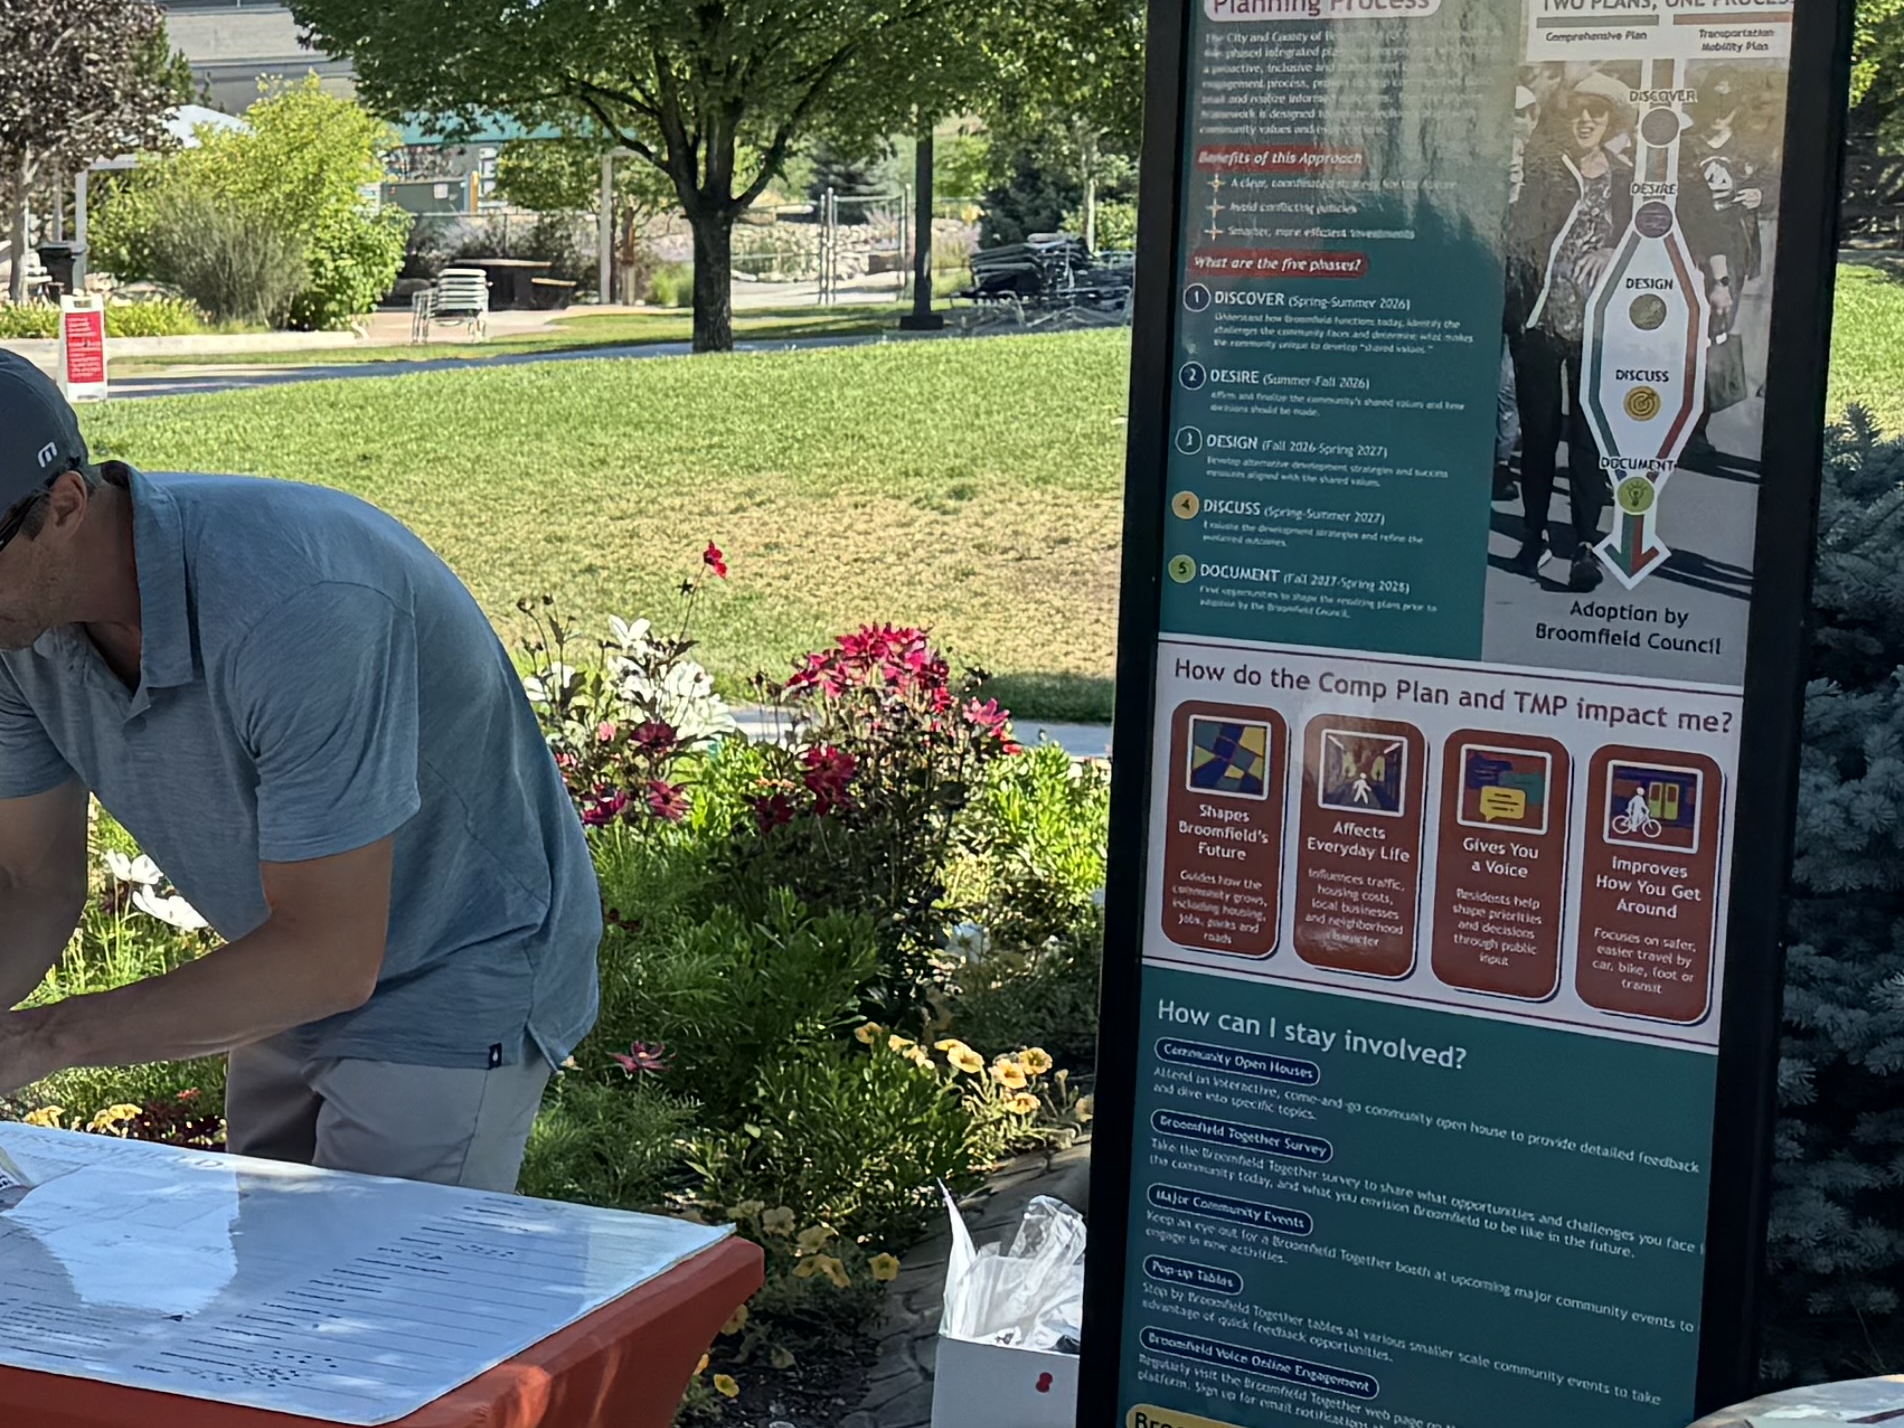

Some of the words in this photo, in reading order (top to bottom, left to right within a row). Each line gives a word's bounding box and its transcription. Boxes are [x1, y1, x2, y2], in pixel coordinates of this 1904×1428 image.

[1624, 30, 1647, 39] Plan
[1628, 89, 1697, 102] DISCOVER
[1198, 151, 1250, 165] Benefits
[1253, 150, 1269, 166] of
[1271, 151, 1296, 163] this
[1298, 152, 1362, 169] Approach
[1630, 182, 1678, 195] DESIRE
[1231, 259, 1253, 268] are
[1257, 257, 1278, 269] the
[1281, 257, 1307, 271] five
[1309, 258, 1361, 271] phases?
[1625, 277, 1673, 289] DESIGN
[1214, 290, 1284, 305] DISCOVER
[1210, 369, 1259, 384] DESIRE
[1615, 368, 1669, 382] DISCUSS
[1206, 433, 1258, 449] DESIGN
[1261, 439, 1285, 450] (Fall
[1598, 454, 1673, 473] DOCUMENT
[1203, 499, 1261, 516] DISCUSS
[1200, 563, 1280, 581] DOCUMENT
[1569, 600, 1657, 622] Adoption
[1664, 607, 1688, 628] by
[1535, 622, 1640, 647] Broomfield
[1647, 632, 1720, 654] Council
[1174, 657, 1225, 681] How
[1233, 663, 1261, 685] do
[1270, 667, 1310, 690] the
[1318, 671, 1386, 702] Comp
[1396, 679, 1448, 705] Plan
[1458, 689, 1505, 710] and
[1513, 690, 1567, 716] TMP
[1576, 697, 1667, 727] impact
[1677, 711, 1732, 733] me?
[1199, 803, 1249, 822] Shapes
[1178, 820, 1268, 843] Broomfield's
[1333, 821, 1385, 839] Affects
[1198, 841, 1246, 860] Future
[1307, 836, 1375, 860] Everyday
[1380, 846, 1409, 862] Life
[1462, 837, 1505, 854] Gives
[1509, 842, 1538, 858] You
[1471, 861, 1480, 871] a
[1485, 859, 1527, 877] Voice
[1612, 855, 1687, 878] Improves
[1596, 874, 1631, 891] How
[1637, 879, 1665, 896] You
[1671, 884, 1700, 901] Get
[1616, 898, 1677, 918] Around
[1593, 927, 1640, 943] Focuses
[1643, 936, 1659, 946] on
[1636, 949, 1672, 963] travel
[1676, 954, 1692, 968] by
[1158, 998, 1209, 1025] How
[1218, 1014, 1260, 1035] can
[1270, 1016, 1275, 1038] I
[1284, 1022, 1336, 1052] stay
[1344, 1029, 1466, 1069] involved?
[1234, 1055, 1266, 1070] Open
[1269, 1060, 1312, 1078] Houses
[1228, 1127, 1280, 1146] Together
[1284, 1137, 1330, 1161] Survey
[1579, 1141, 1634, 1161] detailed
[1638, 1151, 1698, 1172] feedback
[1294, 1364, 1371, 1397] Engagement
